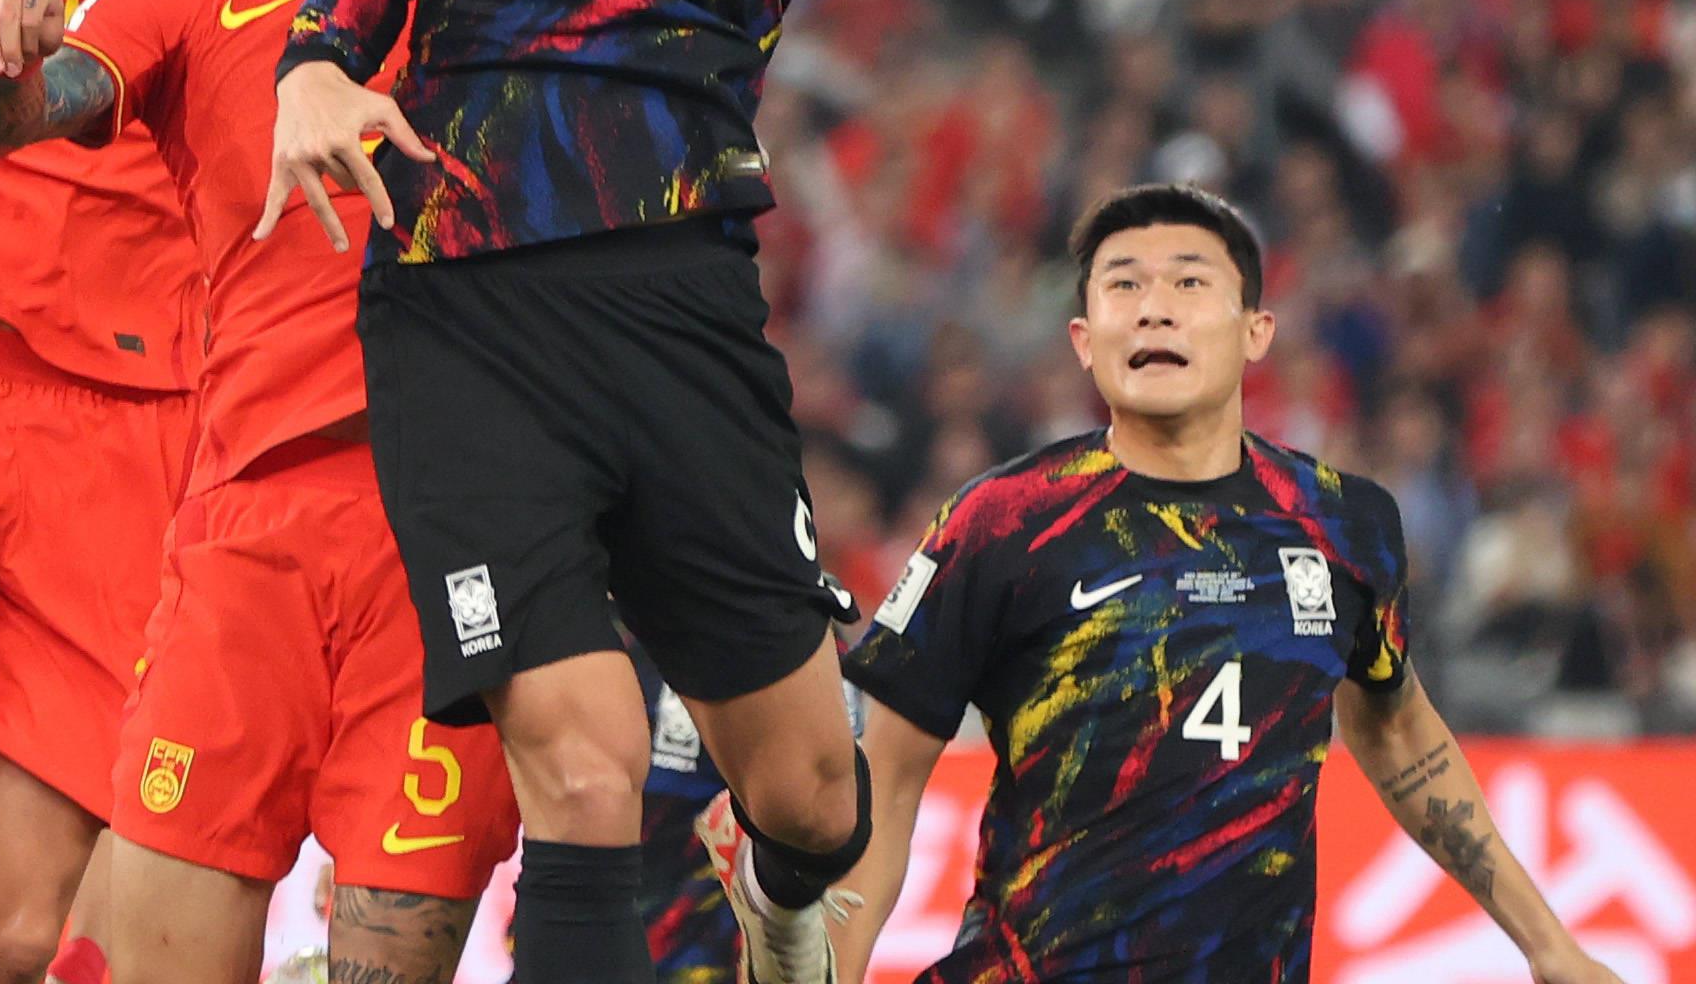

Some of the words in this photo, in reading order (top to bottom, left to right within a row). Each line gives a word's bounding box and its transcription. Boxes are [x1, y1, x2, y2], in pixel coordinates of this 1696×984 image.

[460, 633, 503, 658] KOREA
[1181, 661, 1252, 762] 4
[402, 716, 463, 817] 5
